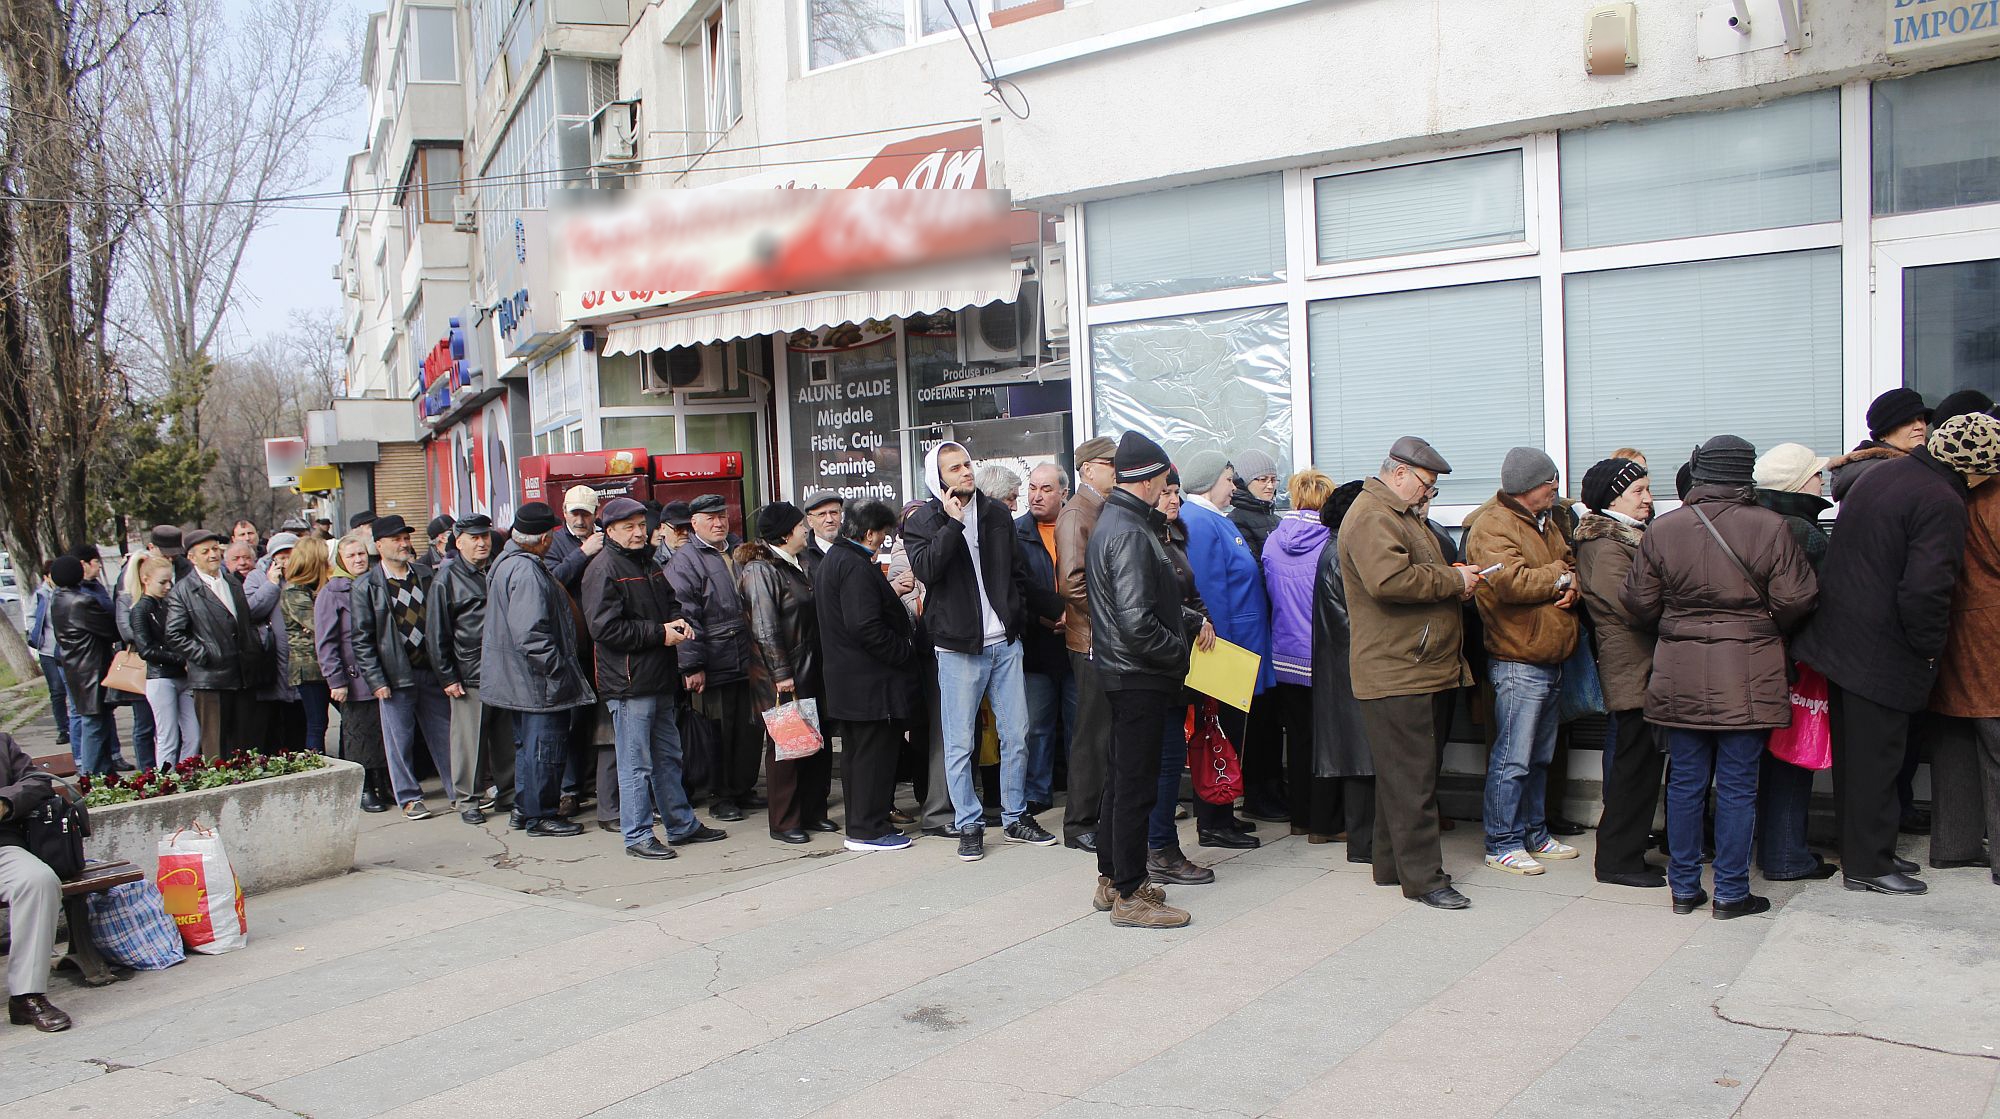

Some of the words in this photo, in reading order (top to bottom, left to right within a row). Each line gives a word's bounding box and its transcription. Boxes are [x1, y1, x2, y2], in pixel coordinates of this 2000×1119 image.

[943, 365, 980, 381] Produse
[798, 384, 842, 403] ALUNE
[846, 379, 891, 399] CALDE
[818, 406, 873, 429] Migdale
[811, 433, 847, 452] Fistic,
[851, 431, 883, 452] Caju
